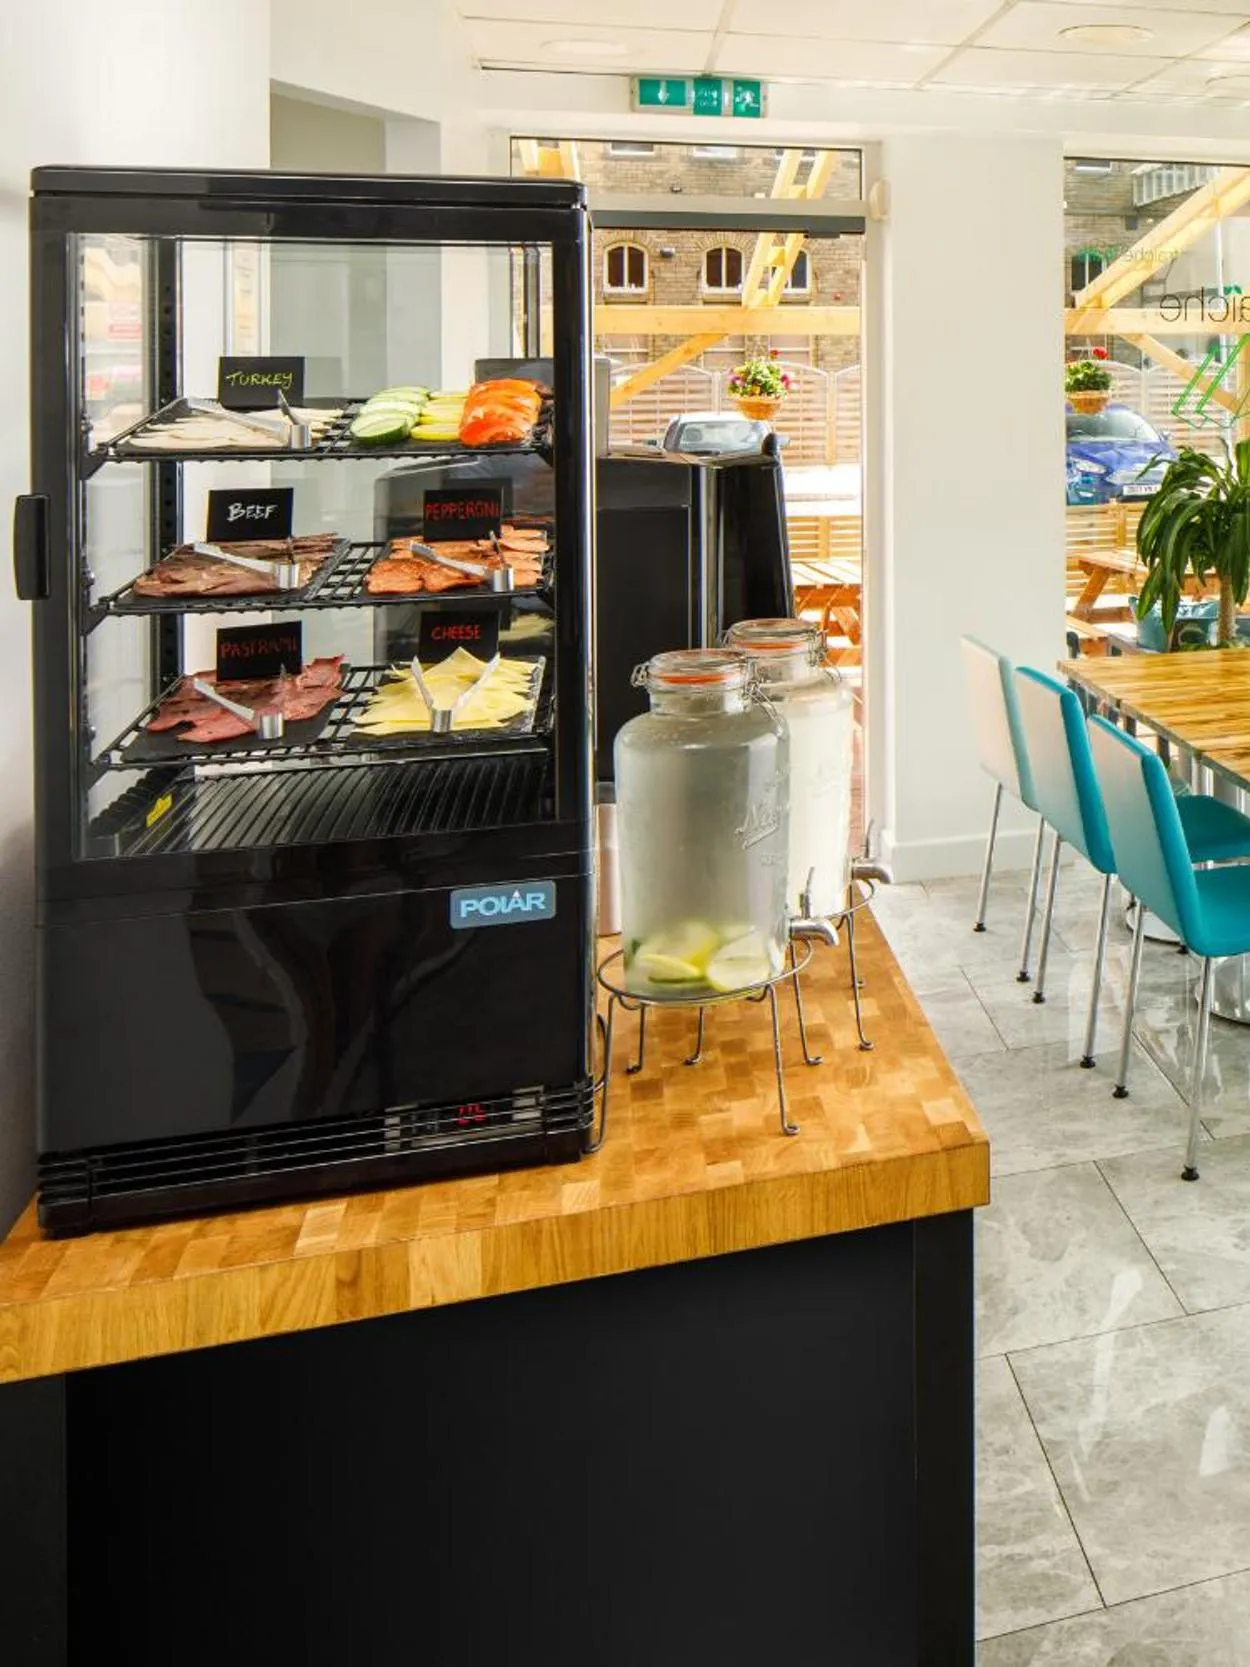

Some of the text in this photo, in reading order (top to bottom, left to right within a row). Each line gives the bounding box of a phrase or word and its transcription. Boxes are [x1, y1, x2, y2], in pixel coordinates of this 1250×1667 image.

[226, 371, 293, 391] TURKEY
[227, 502, 278, 522] BEEF
[431, 624, 481, 641] CHEESE
[460, 889, 547, 918] POLAR
